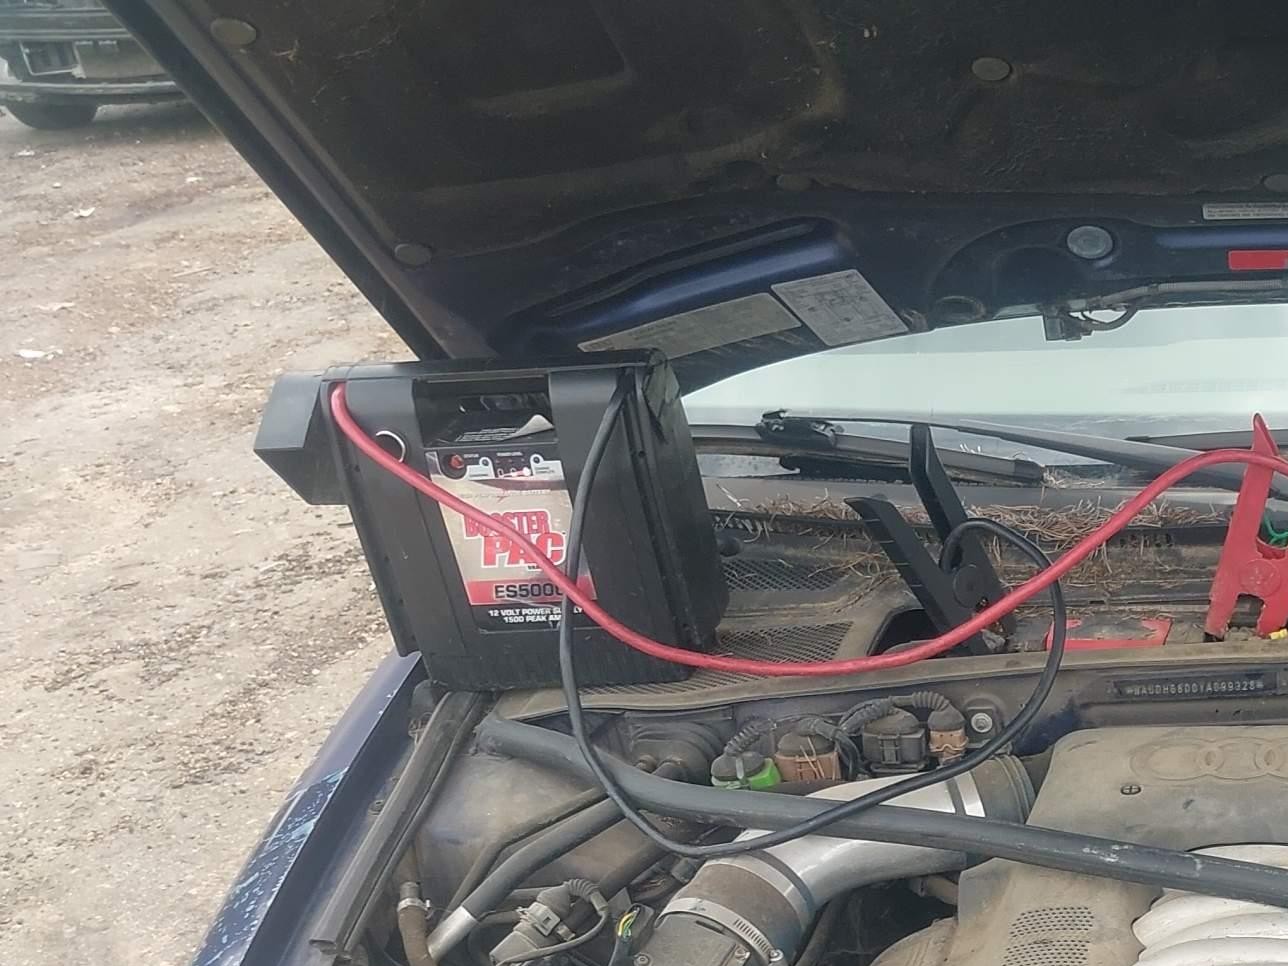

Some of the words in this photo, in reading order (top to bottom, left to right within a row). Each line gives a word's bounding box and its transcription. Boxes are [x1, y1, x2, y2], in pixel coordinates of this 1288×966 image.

[482, 531, 566, 567] PAC
[488, 609, 500, 617] 12
[500, 608, 521, 616] VOLT
[521, 607, 551, 616] POWER
[552, 606, 583, 614] SLY
[503, 615, 525, 624] 1500
